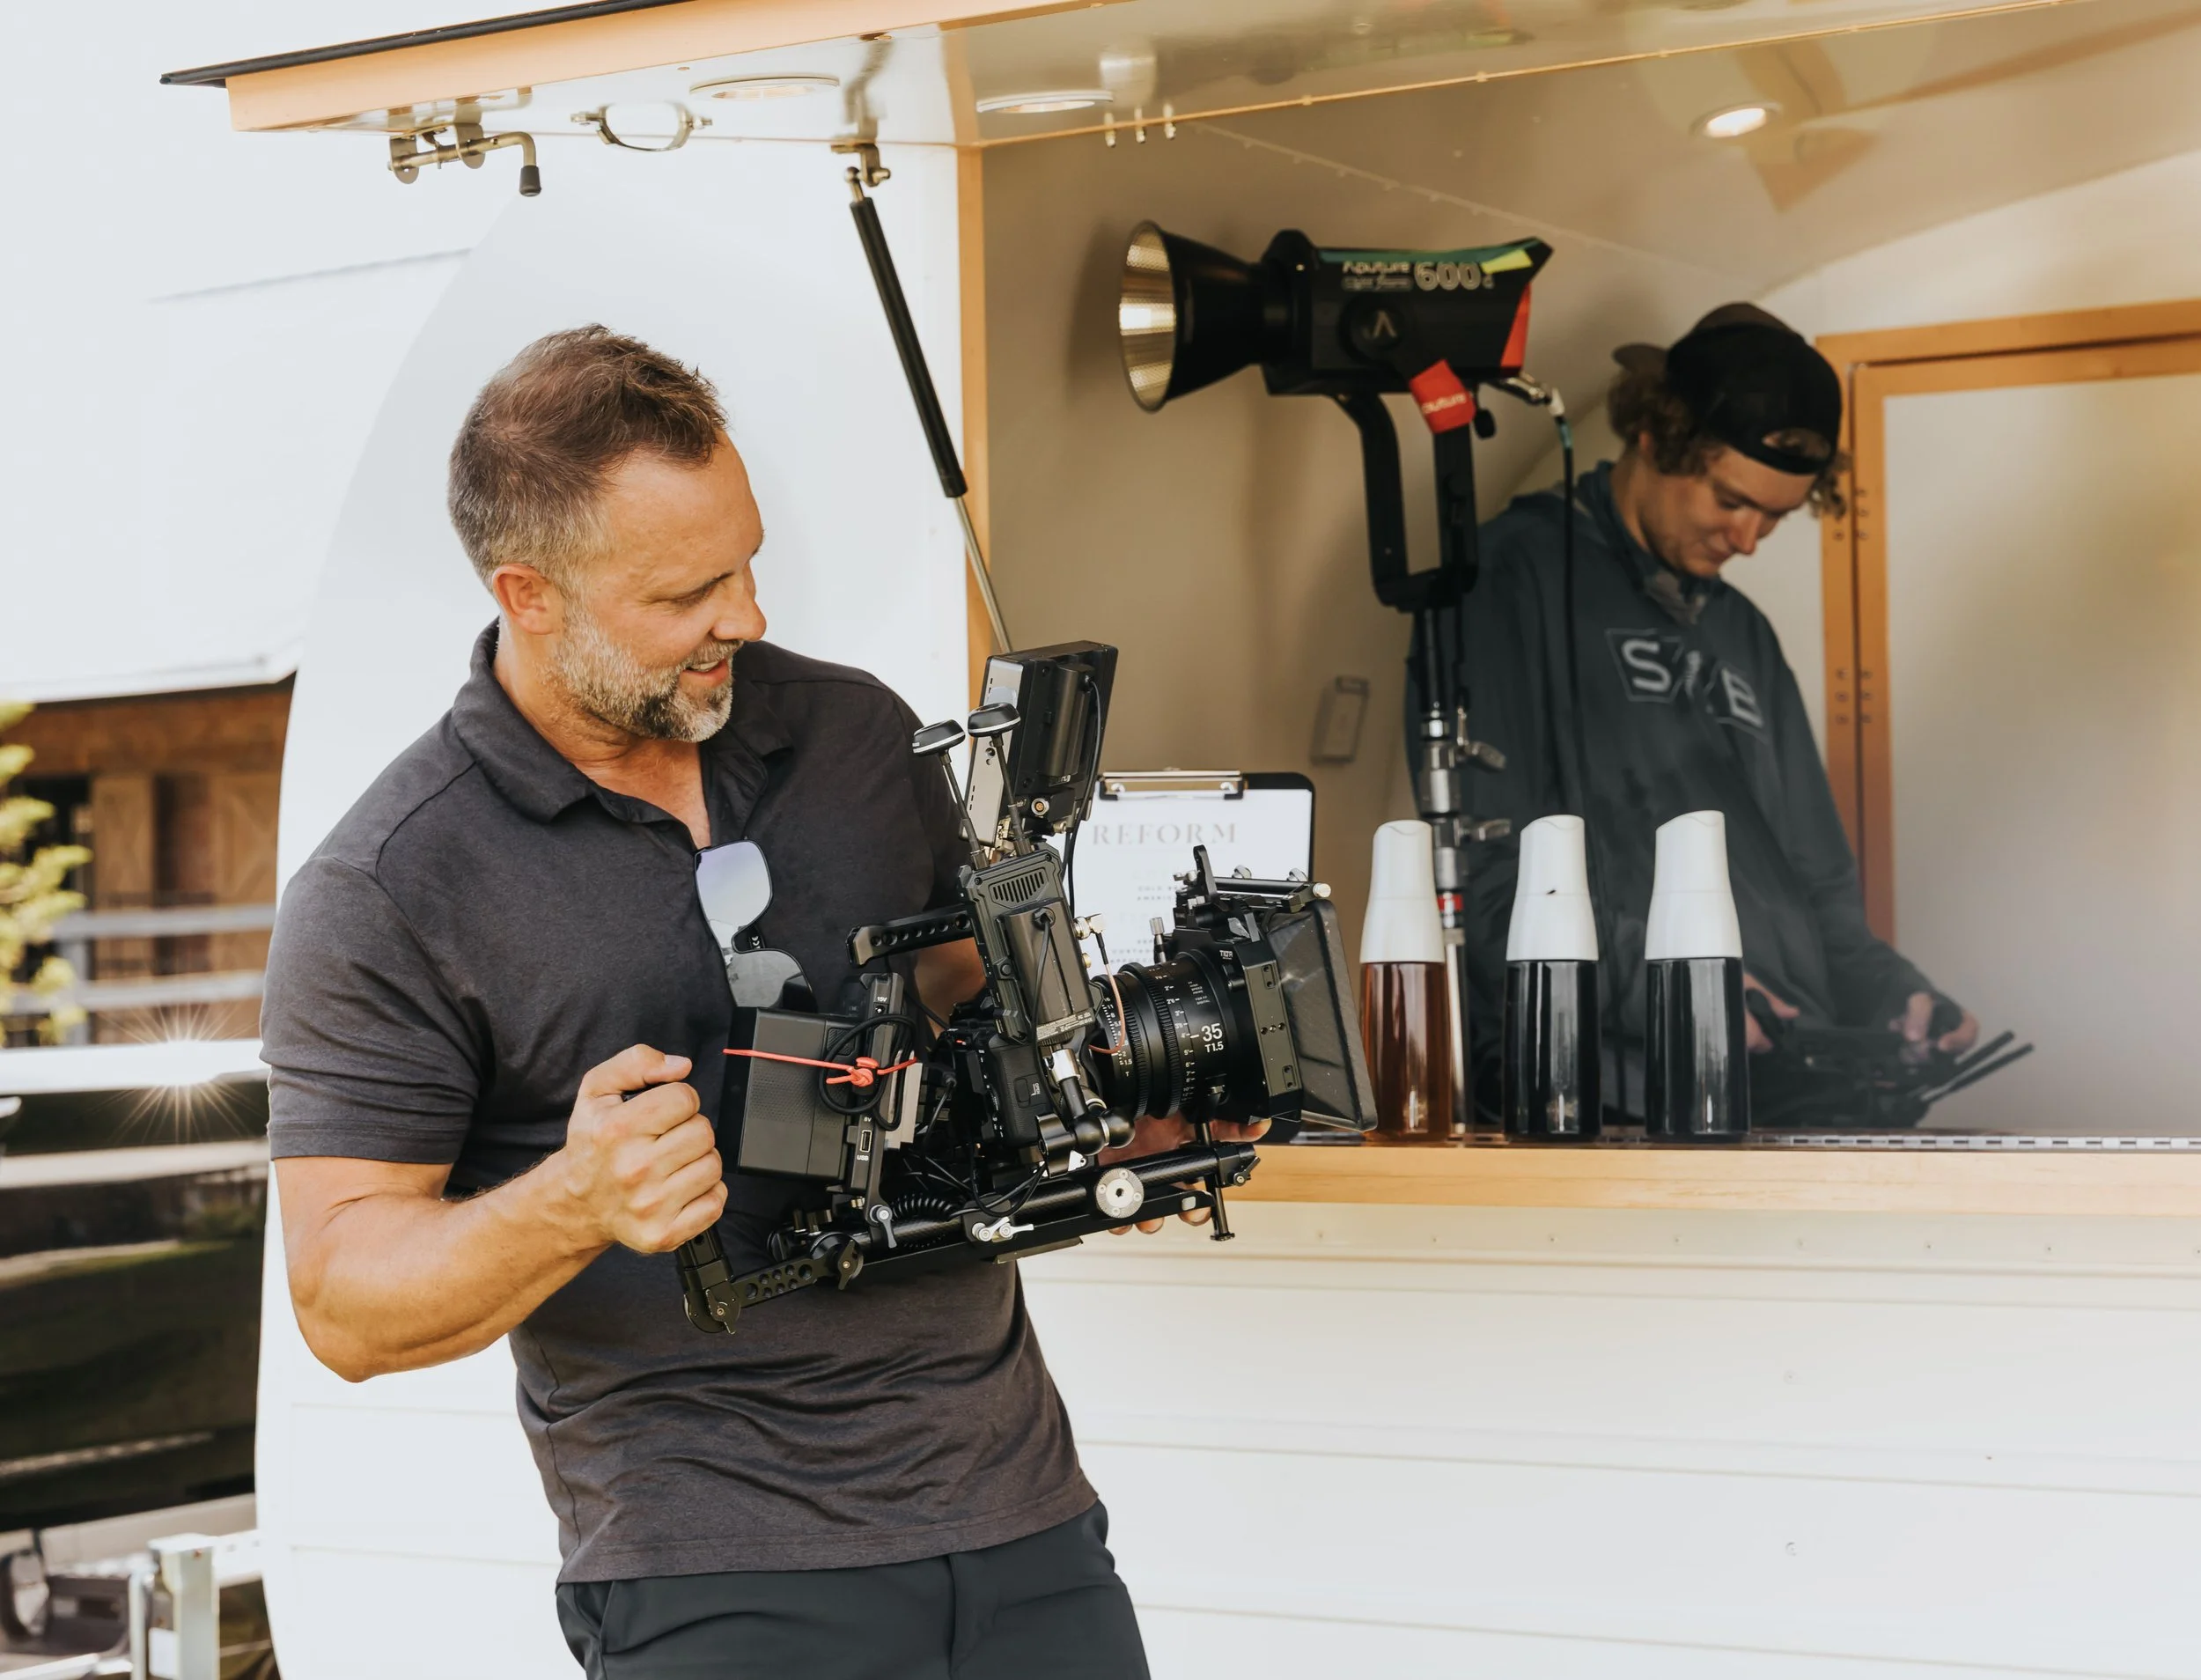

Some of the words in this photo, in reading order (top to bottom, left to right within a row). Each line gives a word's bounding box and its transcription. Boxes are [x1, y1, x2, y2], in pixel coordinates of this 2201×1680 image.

[1093, 822, 1237, 846] REFORM
[1201, 1022, 1223, 1042] 35
[1204, 1041, 1224, 1053] T1.5
